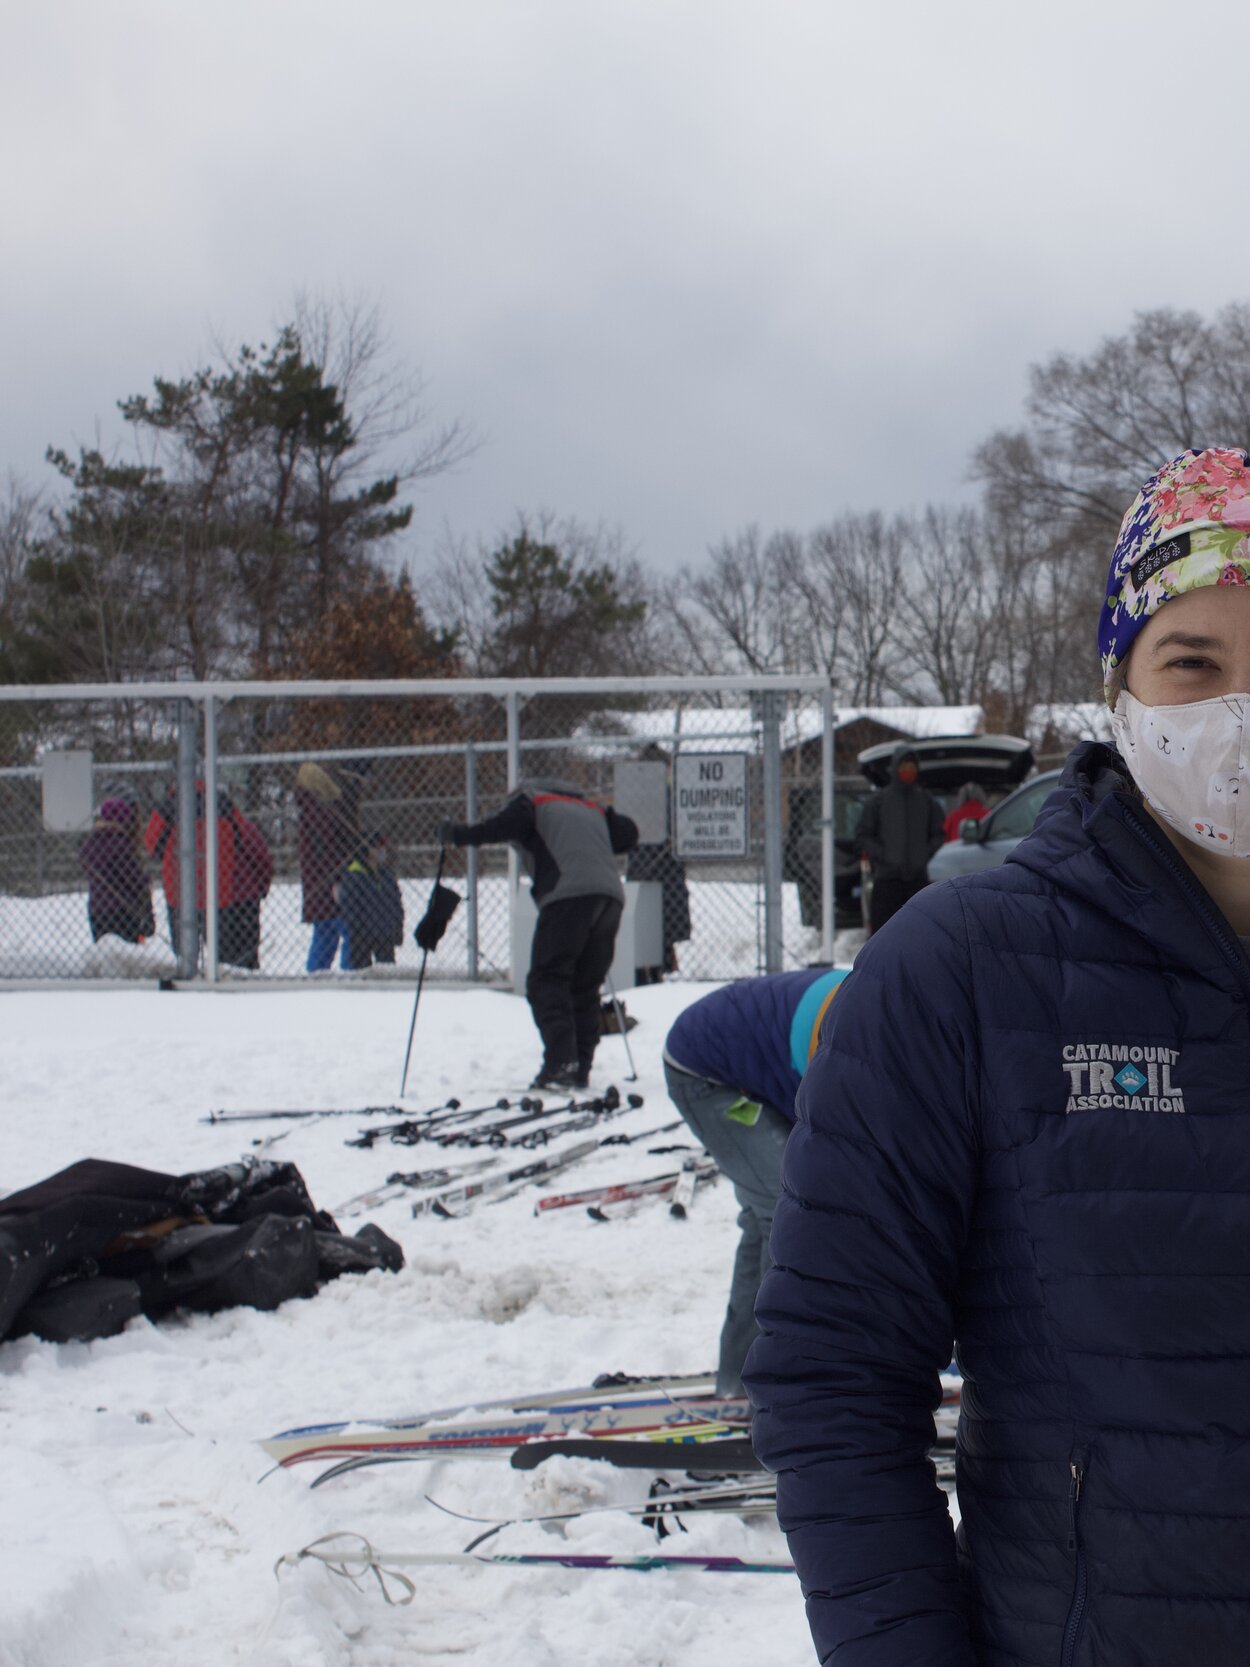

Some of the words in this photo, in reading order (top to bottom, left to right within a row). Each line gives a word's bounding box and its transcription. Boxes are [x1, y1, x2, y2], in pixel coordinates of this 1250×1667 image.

[1139, 544, 1177, 570] SKIDA
[699, 761, 723, 781] NO
[680, 786, 744, 808] DUMPING
[687, 811, 736, 821] VIOLATORS
[694, 825, 715, 836] WILL
[719, 825, 729, 836] BE
[682, 839, 741, 849] PROSECUTED
[1062, 1044, 1180, 1065] CATAMOUNT
[1062, 1061, 1183, 1097] TRIL
[1066, 1094, 1185, 1114] ASSOCIATION
